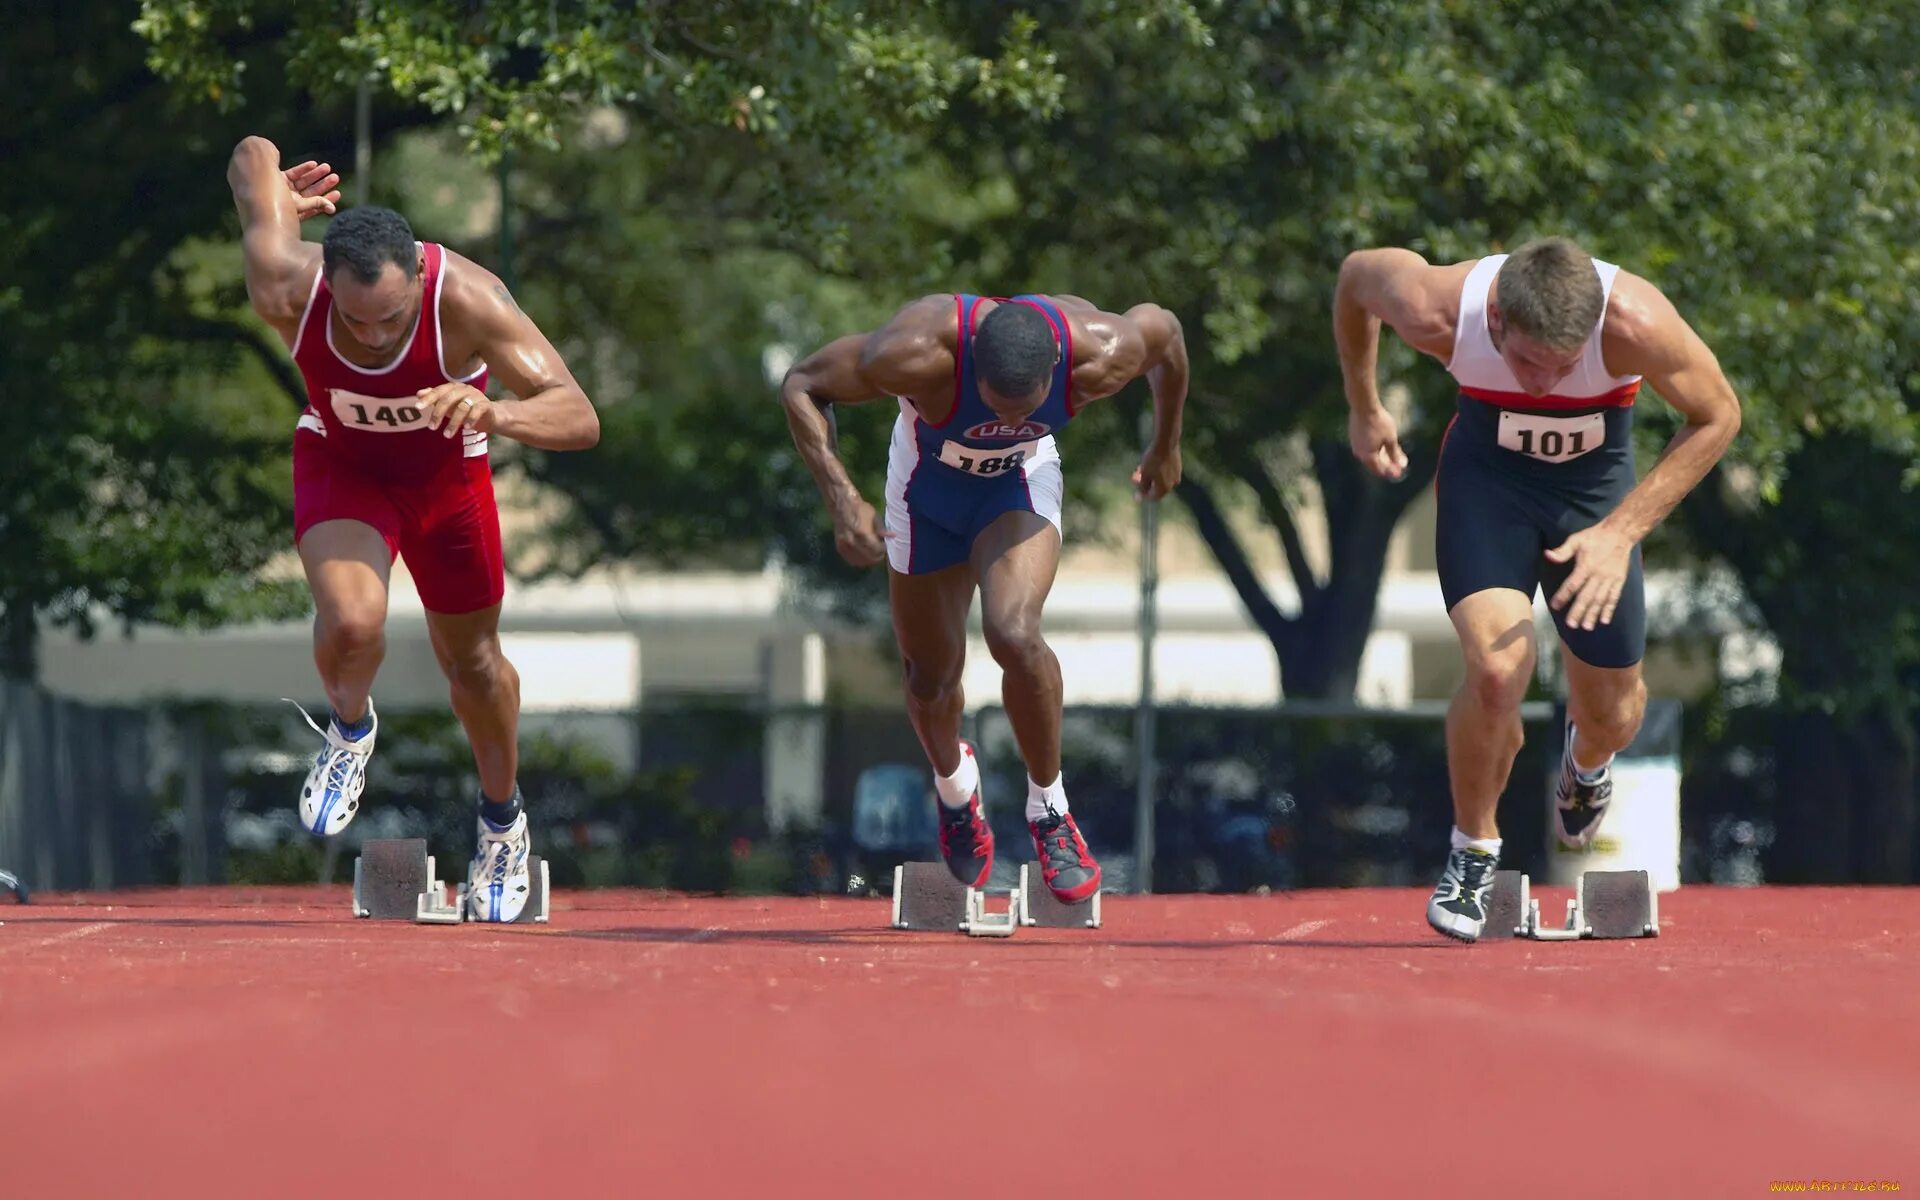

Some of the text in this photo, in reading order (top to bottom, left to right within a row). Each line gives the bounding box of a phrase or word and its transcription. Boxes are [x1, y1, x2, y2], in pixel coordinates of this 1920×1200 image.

[350, 404, 421, 427] 140
[979, 425, 1035, 436] USA
[1518, 429, 1586, 457] 101
[958, 450, 1025, 474] 188
